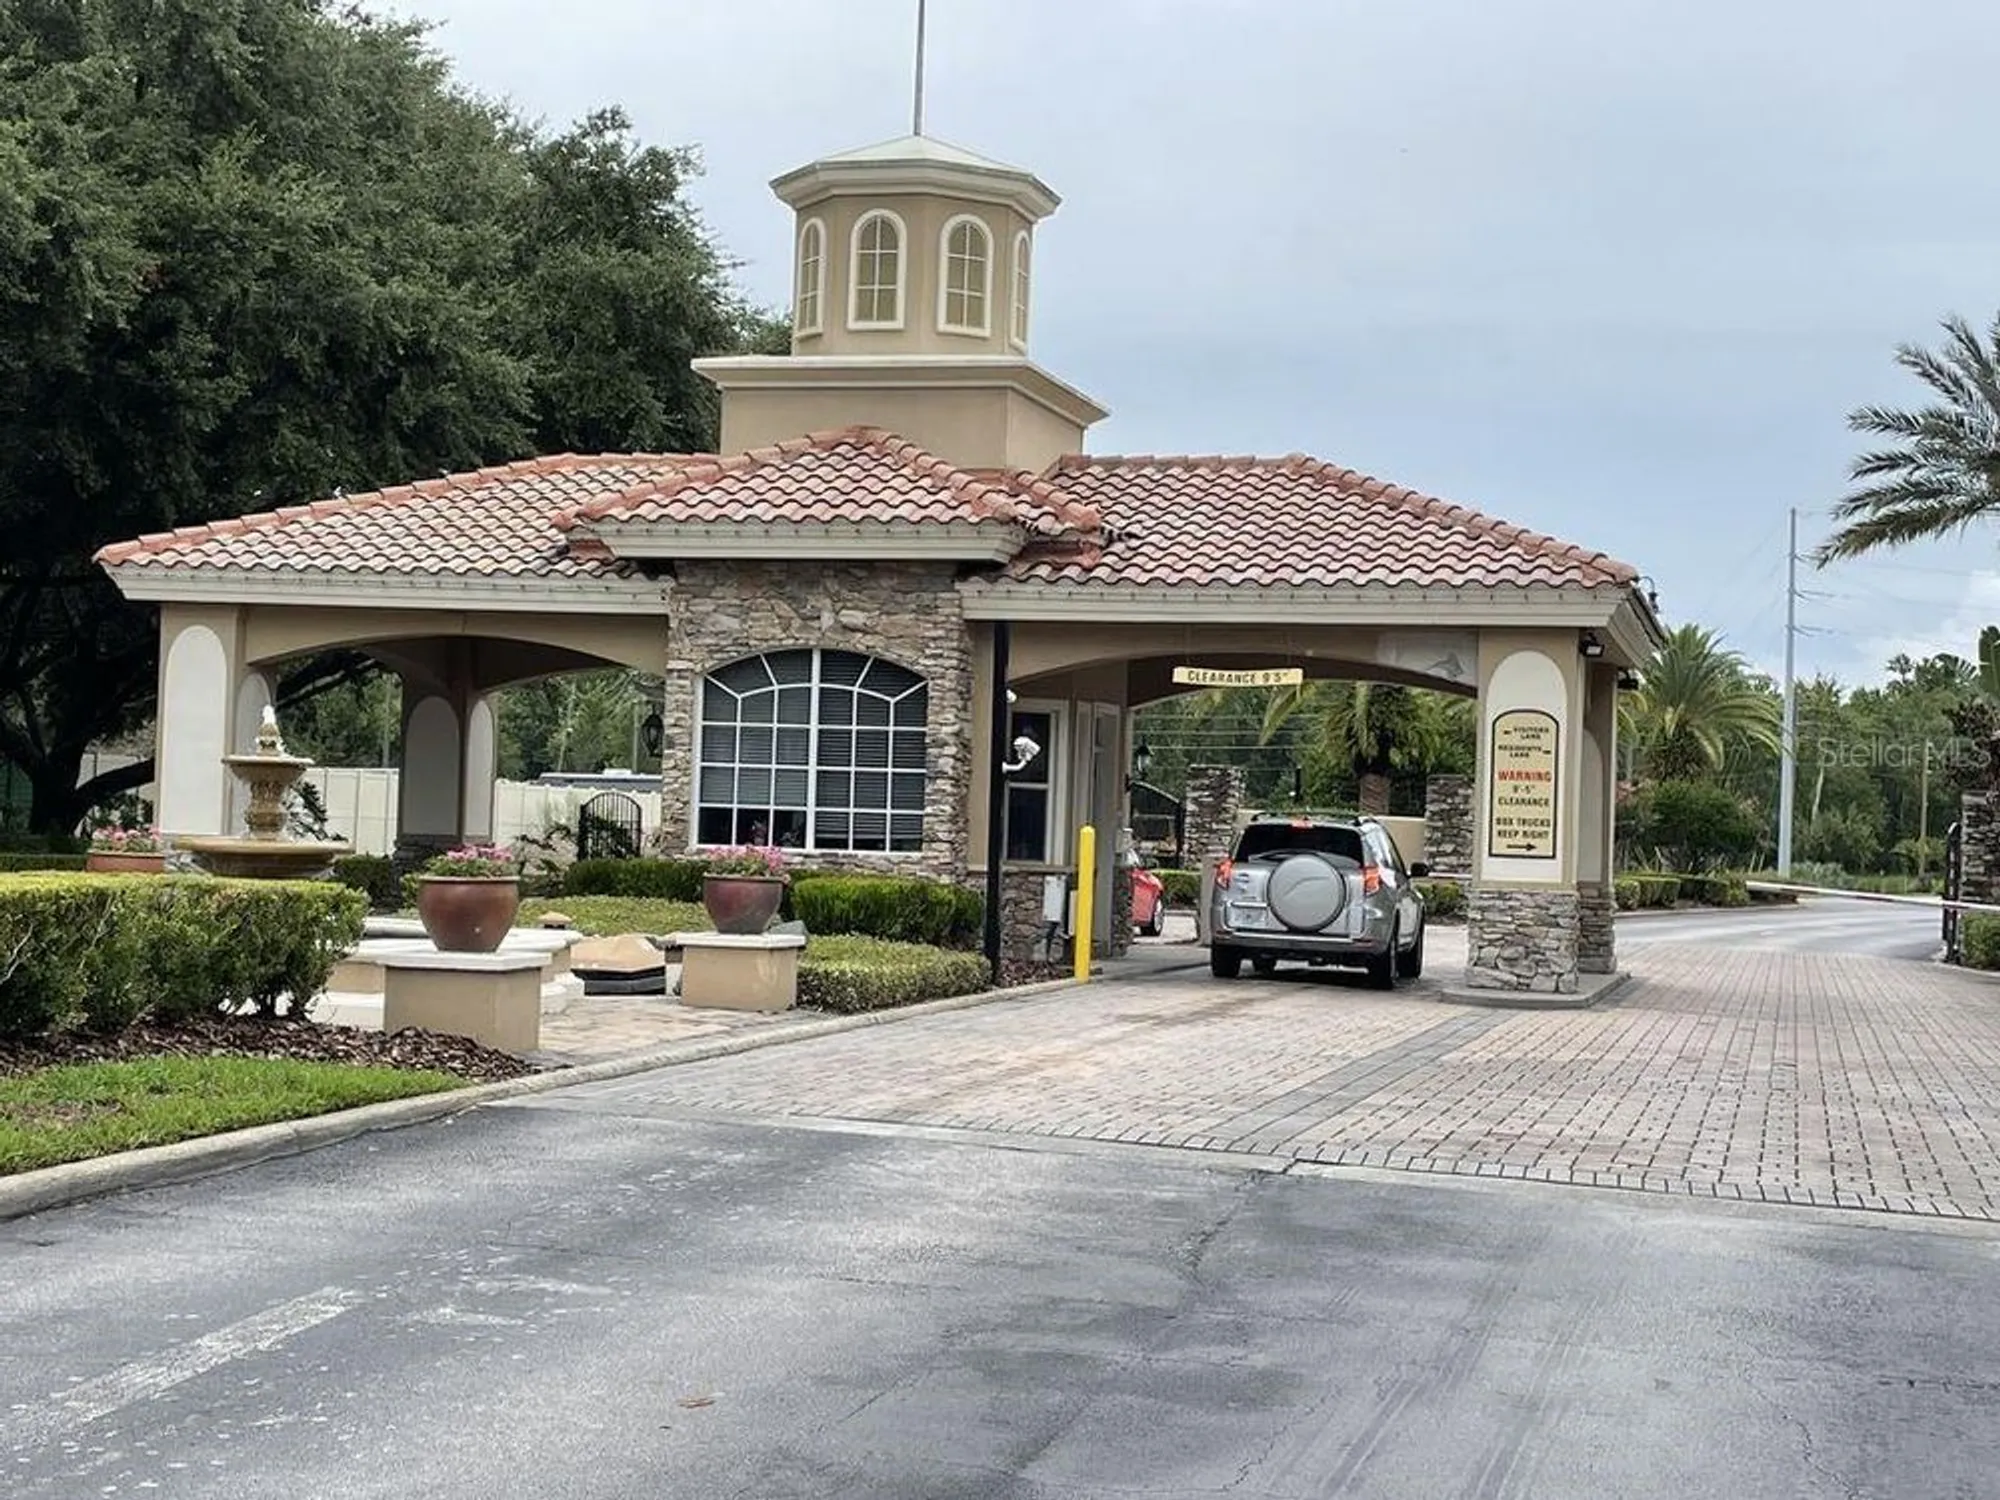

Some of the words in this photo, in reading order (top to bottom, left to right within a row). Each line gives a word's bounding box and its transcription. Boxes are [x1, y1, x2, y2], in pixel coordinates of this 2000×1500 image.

[1187, 670, 1255, 684] CLEARANCE
[1498, 770, 1552, 782] WARNING
[1498, 796, 1550, 807] CLEARANCE
[1496, 817, 1513, 826] BOX
[1516, 818, 1551, 828] TRUCKS
[1497, 829, 1519, 839] KEEP
[1521, 830, 1550, 839] RIGHT
